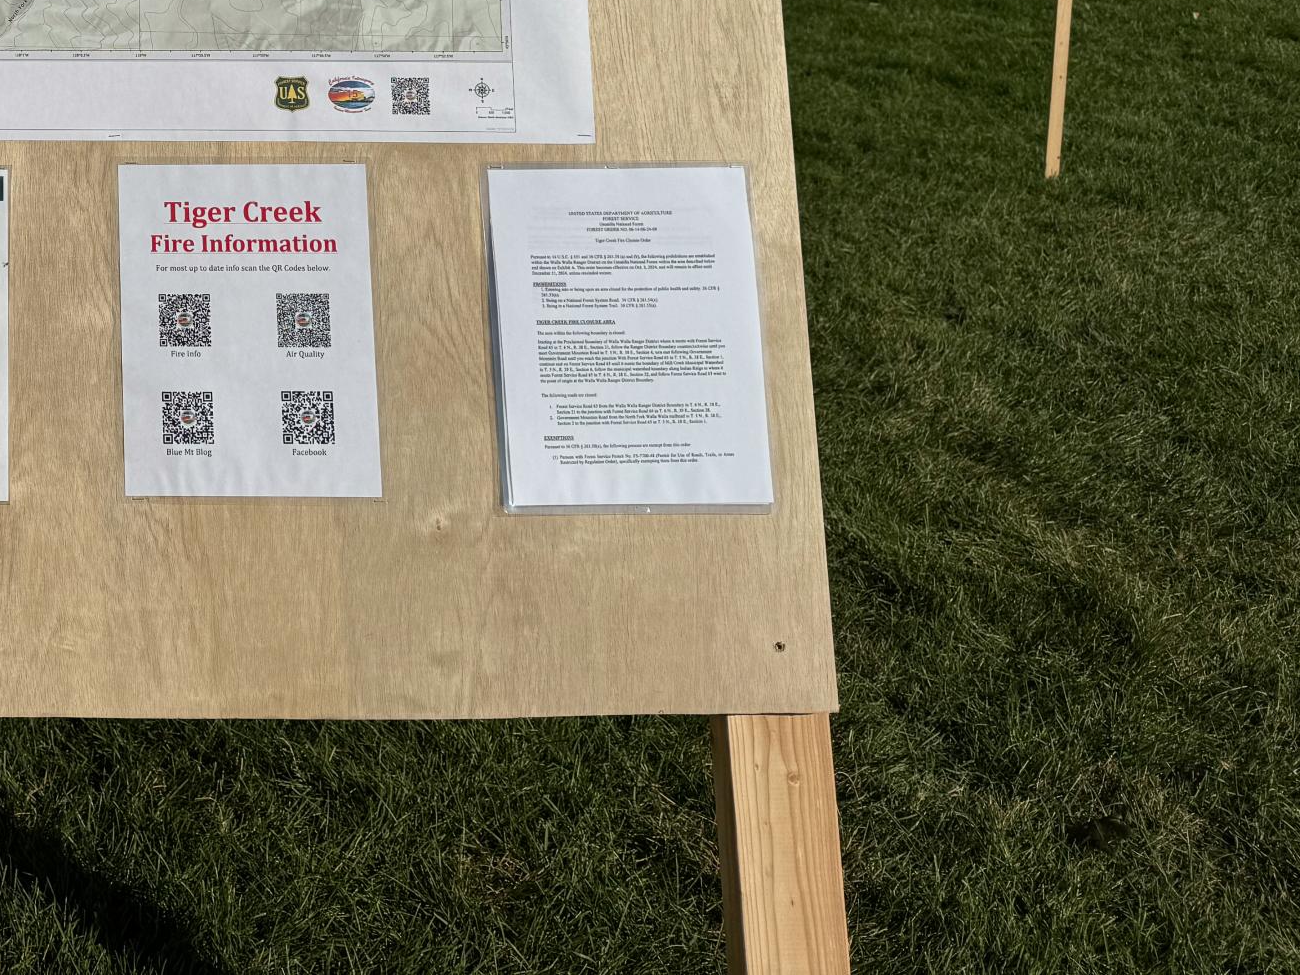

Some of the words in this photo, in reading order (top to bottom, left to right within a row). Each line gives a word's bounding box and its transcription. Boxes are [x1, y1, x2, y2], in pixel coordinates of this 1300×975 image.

[8, 8, 20, 23] North
[164, 201, 236, 229] Tiger
[243, 200, 322, 224] Creek
[150, 234, 195, 253] Fire
[201, 234, 338, 253] Information
[189, 266, 198, 274] up
[271, 265, 283, 273] QR
[170, 350, 185, 358] Fire
[286, 350, 298, 358] Air
[299, 350, 325, 359] Quality
[166, 448, 183, 456] Blue
[184, 448, 194, 456] Mt
[195, 448, 213, 457] Blog
[292, 448, 327, 456] Facebook
